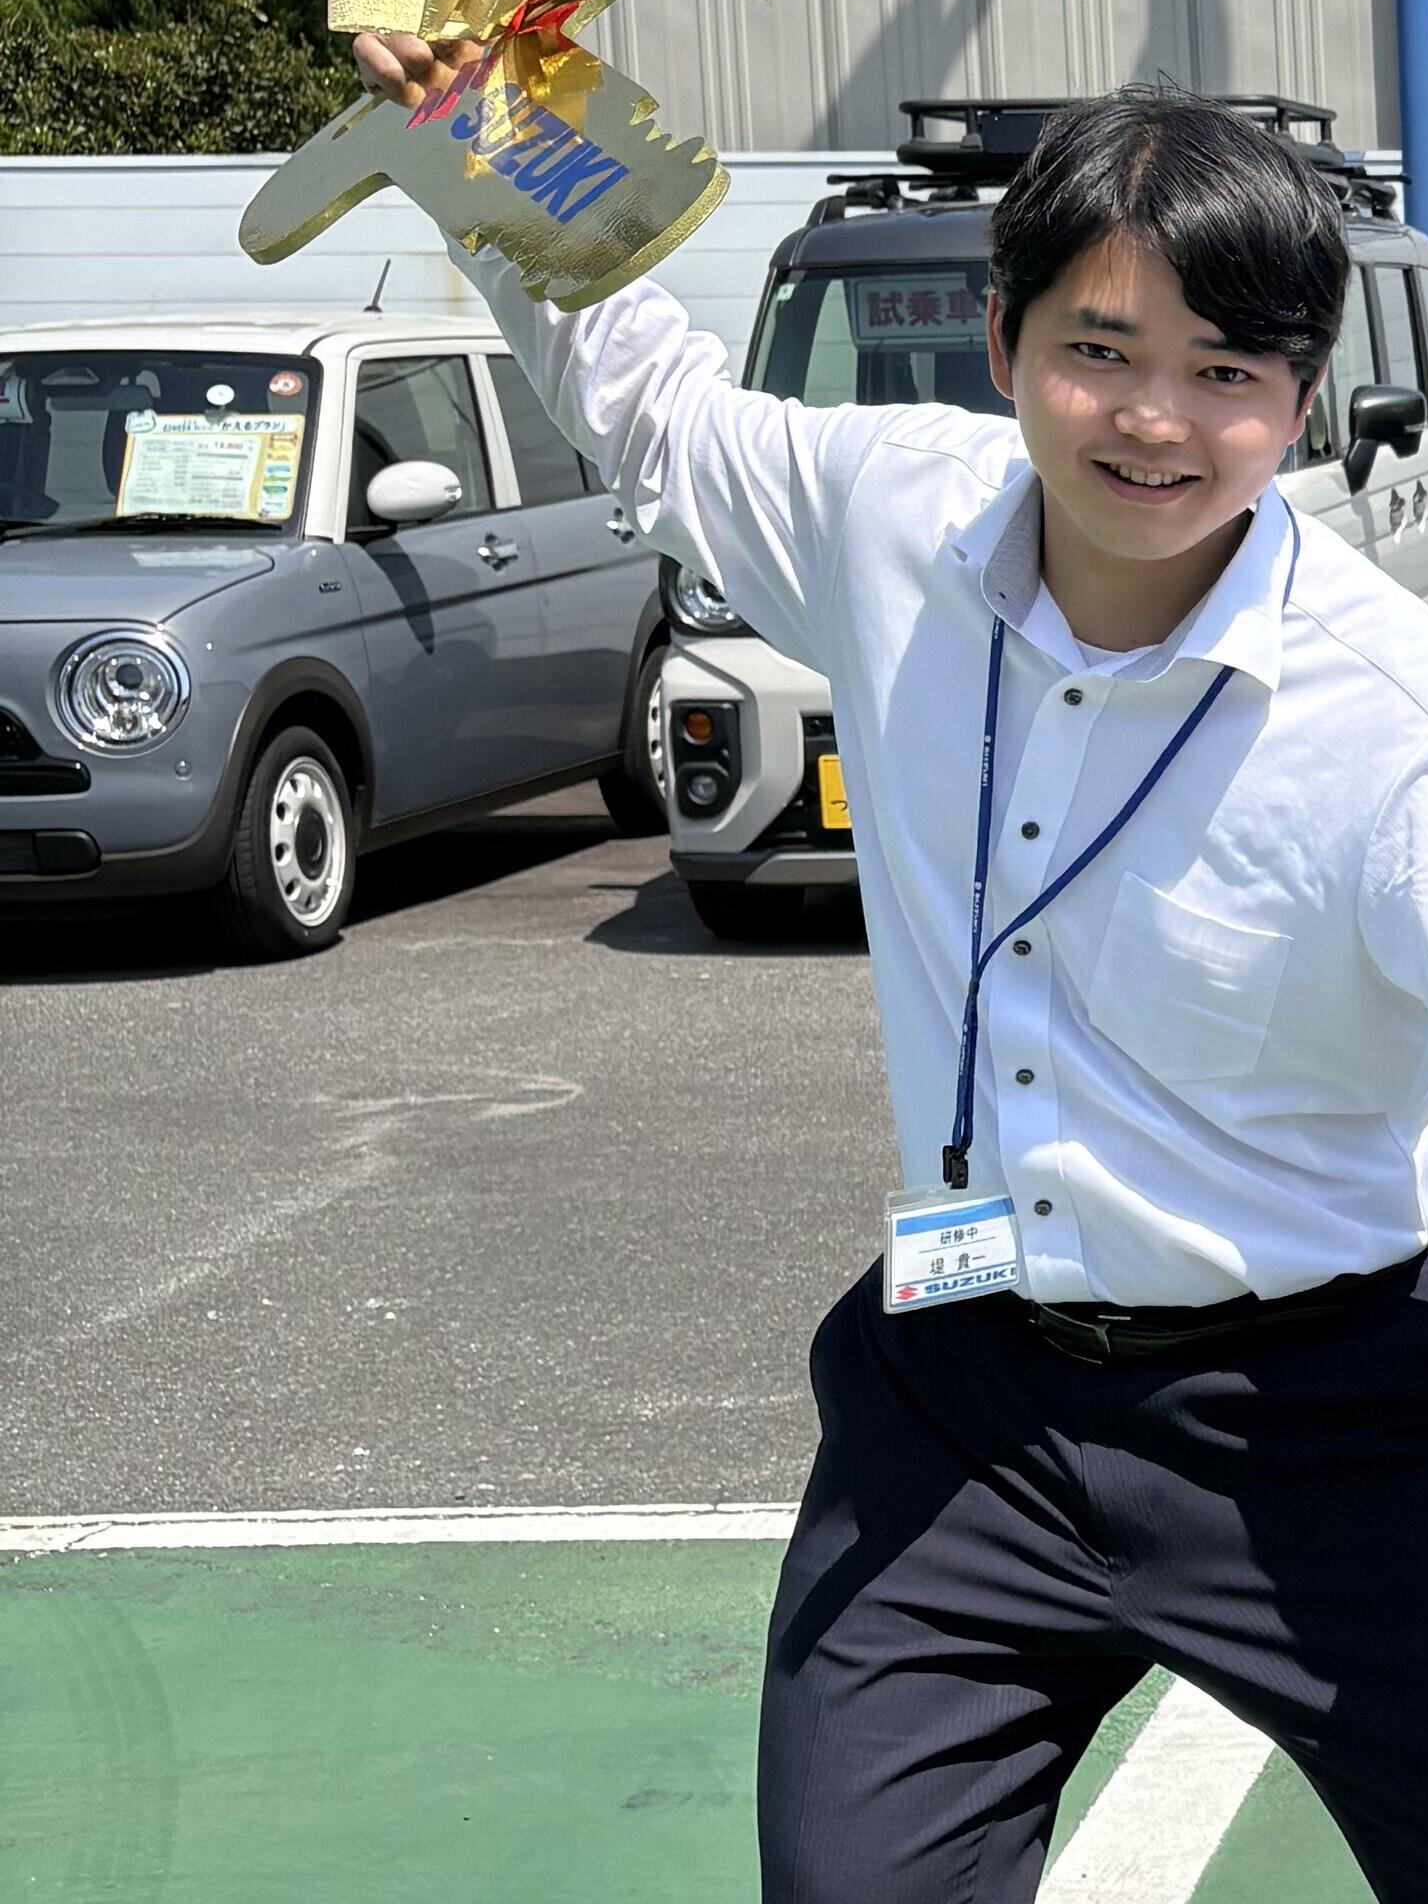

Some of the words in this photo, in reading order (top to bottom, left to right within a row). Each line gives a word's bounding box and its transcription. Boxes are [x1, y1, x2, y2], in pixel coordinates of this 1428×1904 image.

[450, 82, 631, 225] SUZUKI
[867, 289, 983, 328] 試乗車
[940, 1227, 978, 1244] 研修中
[924, 1267, 1016, 1295] SUZUKI
